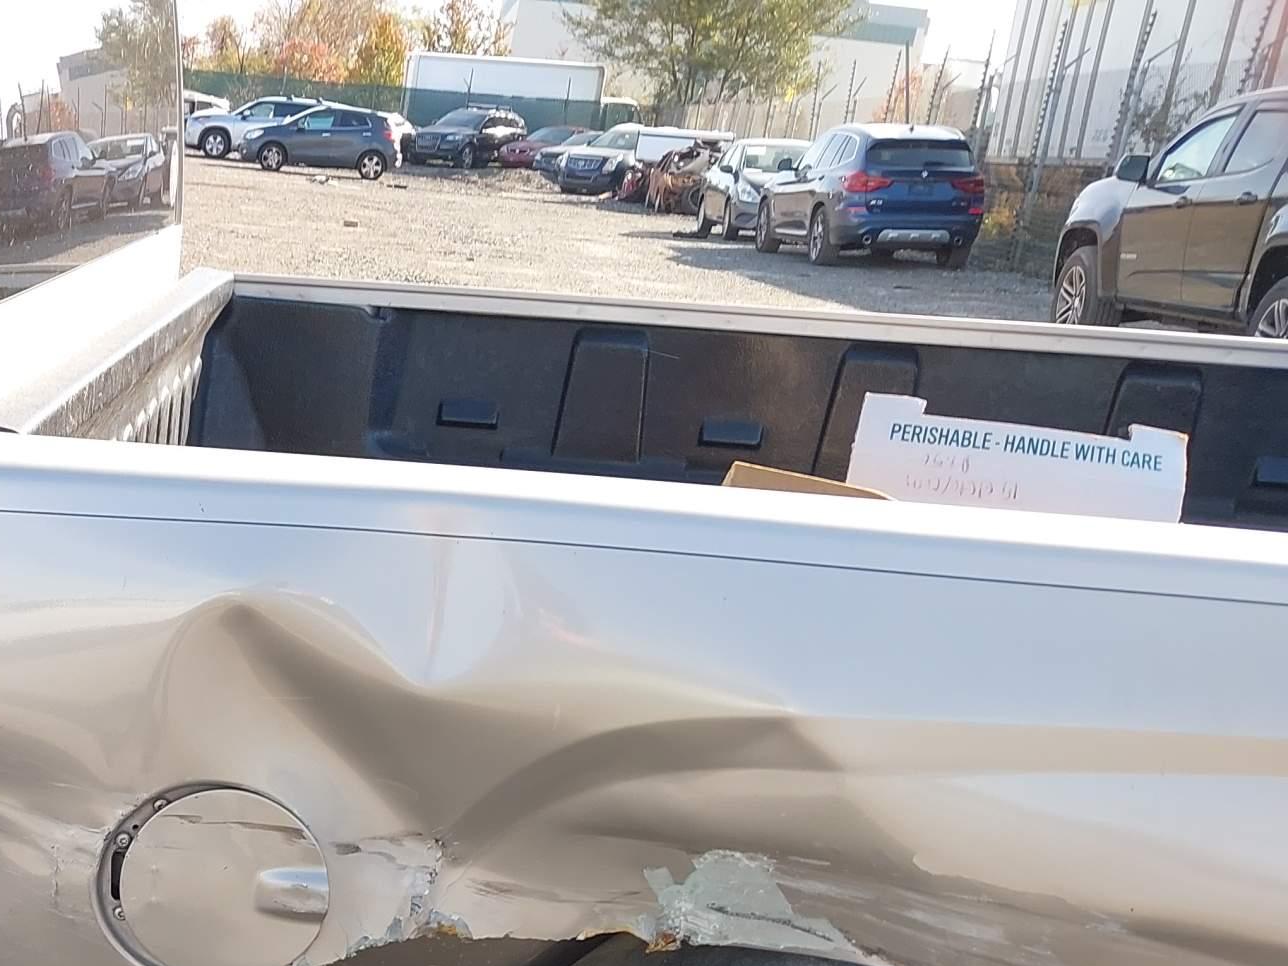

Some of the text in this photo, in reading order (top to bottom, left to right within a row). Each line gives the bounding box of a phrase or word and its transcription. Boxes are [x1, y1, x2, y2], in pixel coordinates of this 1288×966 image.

[889, 423, 993, 450] PERISHABLE
[1003, 436, 1069, 459] HANDLE
[1073, 442, 1117, 465] WITH
[1120, 450, 1162, 471] CARE
